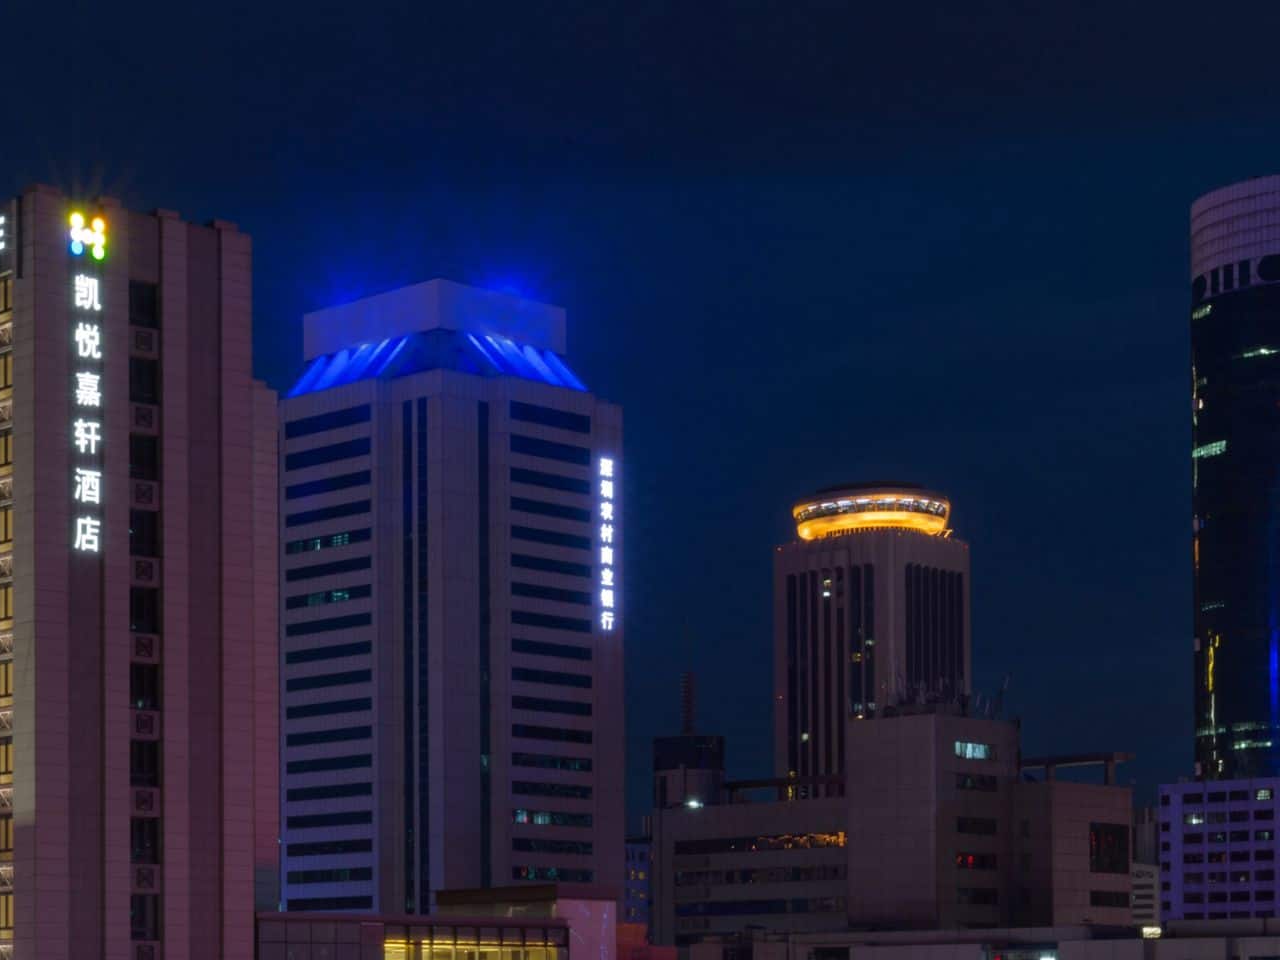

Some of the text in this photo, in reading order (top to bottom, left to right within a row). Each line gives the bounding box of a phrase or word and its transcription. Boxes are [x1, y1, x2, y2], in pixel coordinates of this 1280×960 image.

[73, 273, 103, 553] 凯悦嘉轩酒店
